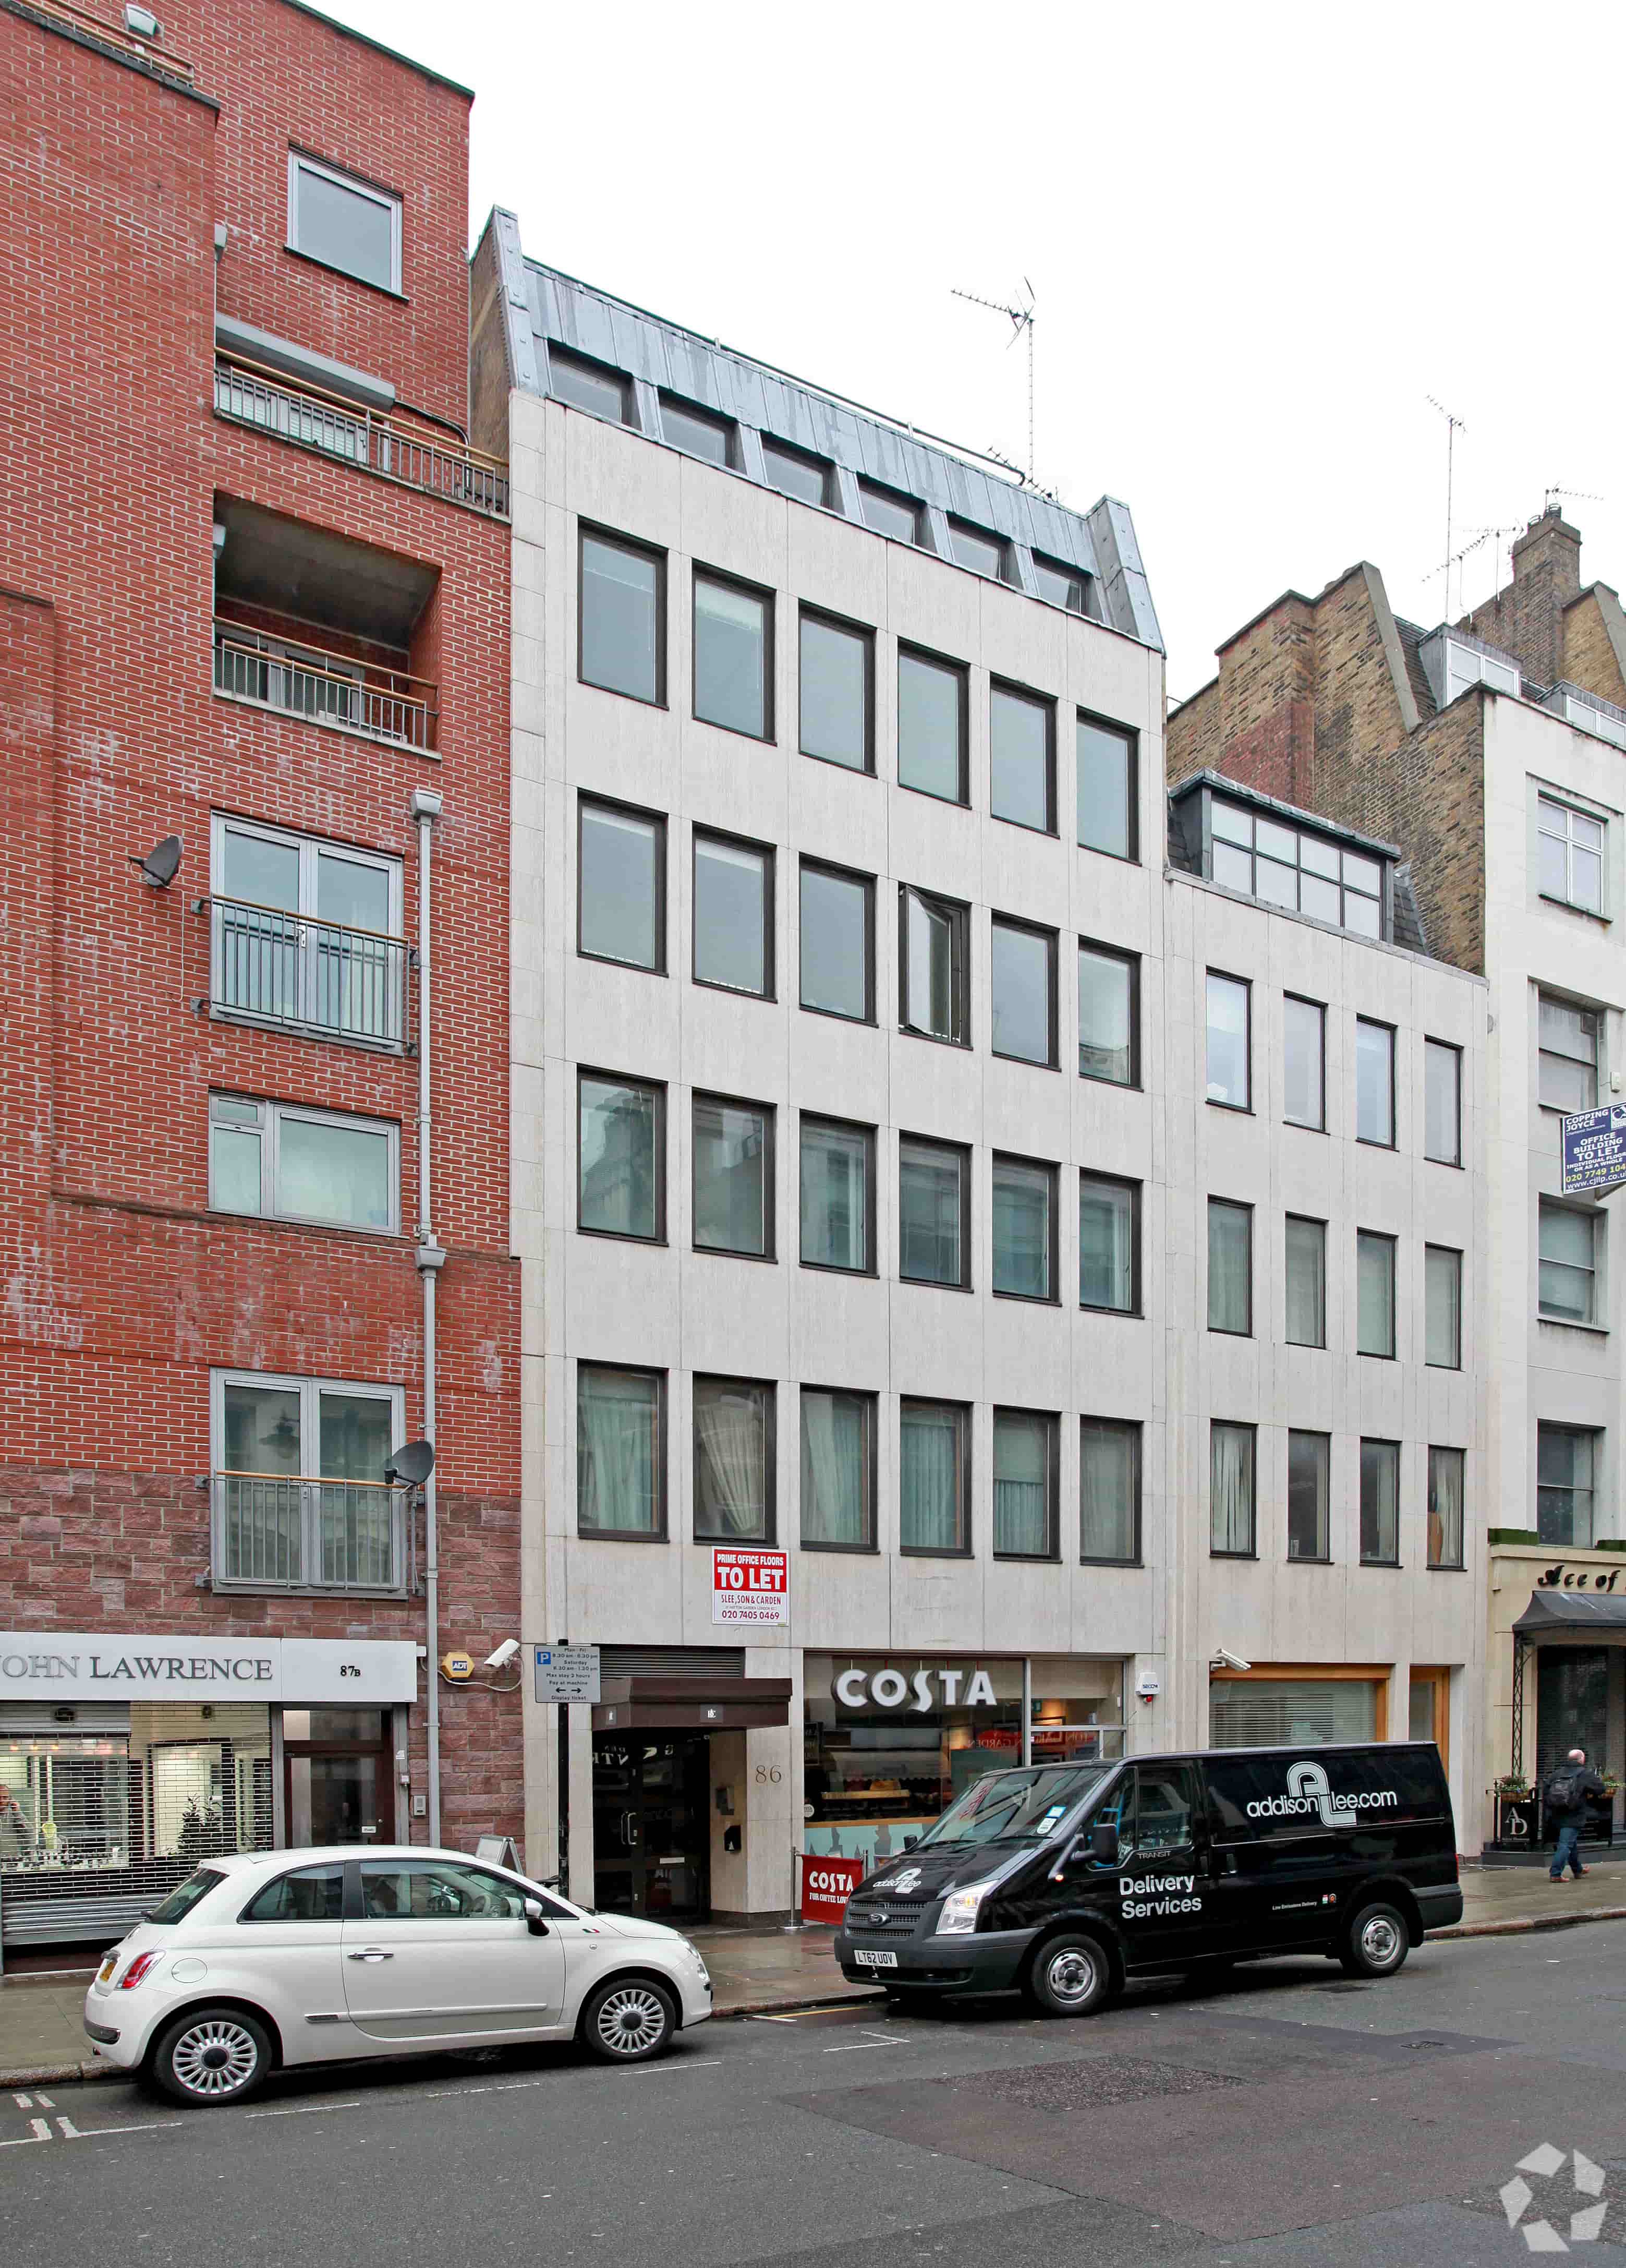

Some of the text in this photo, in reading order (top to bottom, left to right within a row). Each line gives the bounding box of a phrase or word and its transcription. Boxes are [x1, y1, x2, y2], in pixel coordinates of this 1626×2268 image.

[1566, 1109, 1608, 1125] COPPING
[1566, 1119, 1595, 1132] JOYCE
[1573, 1137, 1623, 1154] BUILDING
[1580, 1132, 1616, 1146] OFFICE
[1577, 1144, 1620, 1161] TO LET
[1567, 1157, 1605, 1169] INDIVIDUAL
[1600, 1157, 1623, 1166] WHOLE
[1566, 1174, 1582, 1183] 020
[1585, 1168, 1607, 1178] 7749
[1567, 1169, 1626, 1190] www.cjllp.co.u
[717, 1554, 784, 1566] PRIME OFFICE FLOORS
[717, 1566, 784, 1590] TO LET
[1537, 1565, 1621, 1593] Ace of
[722, 1610, 780, 1620] 020 7405 0469
[0, 1655, 273, 1680] OHN LAWRENCE
[835, 1669, 997, 1712] COSTA
[756, 1765, 781, 1783] 86
[1247, 1791, 1398, 1817] addison lee.com
[1137, 1851, 1171, 1859] TRANSIT
[809, 1871, 853, 1892] COSTA
[1120, 1875, 1194, 1896] Delivery
[809, 1892, 819, 1901] FOR
[820, 1893, 836, 1903] COFFEE
[1122, 1896, 1202, 1919] Services
[857, 1952, 876, 1963] LT62
